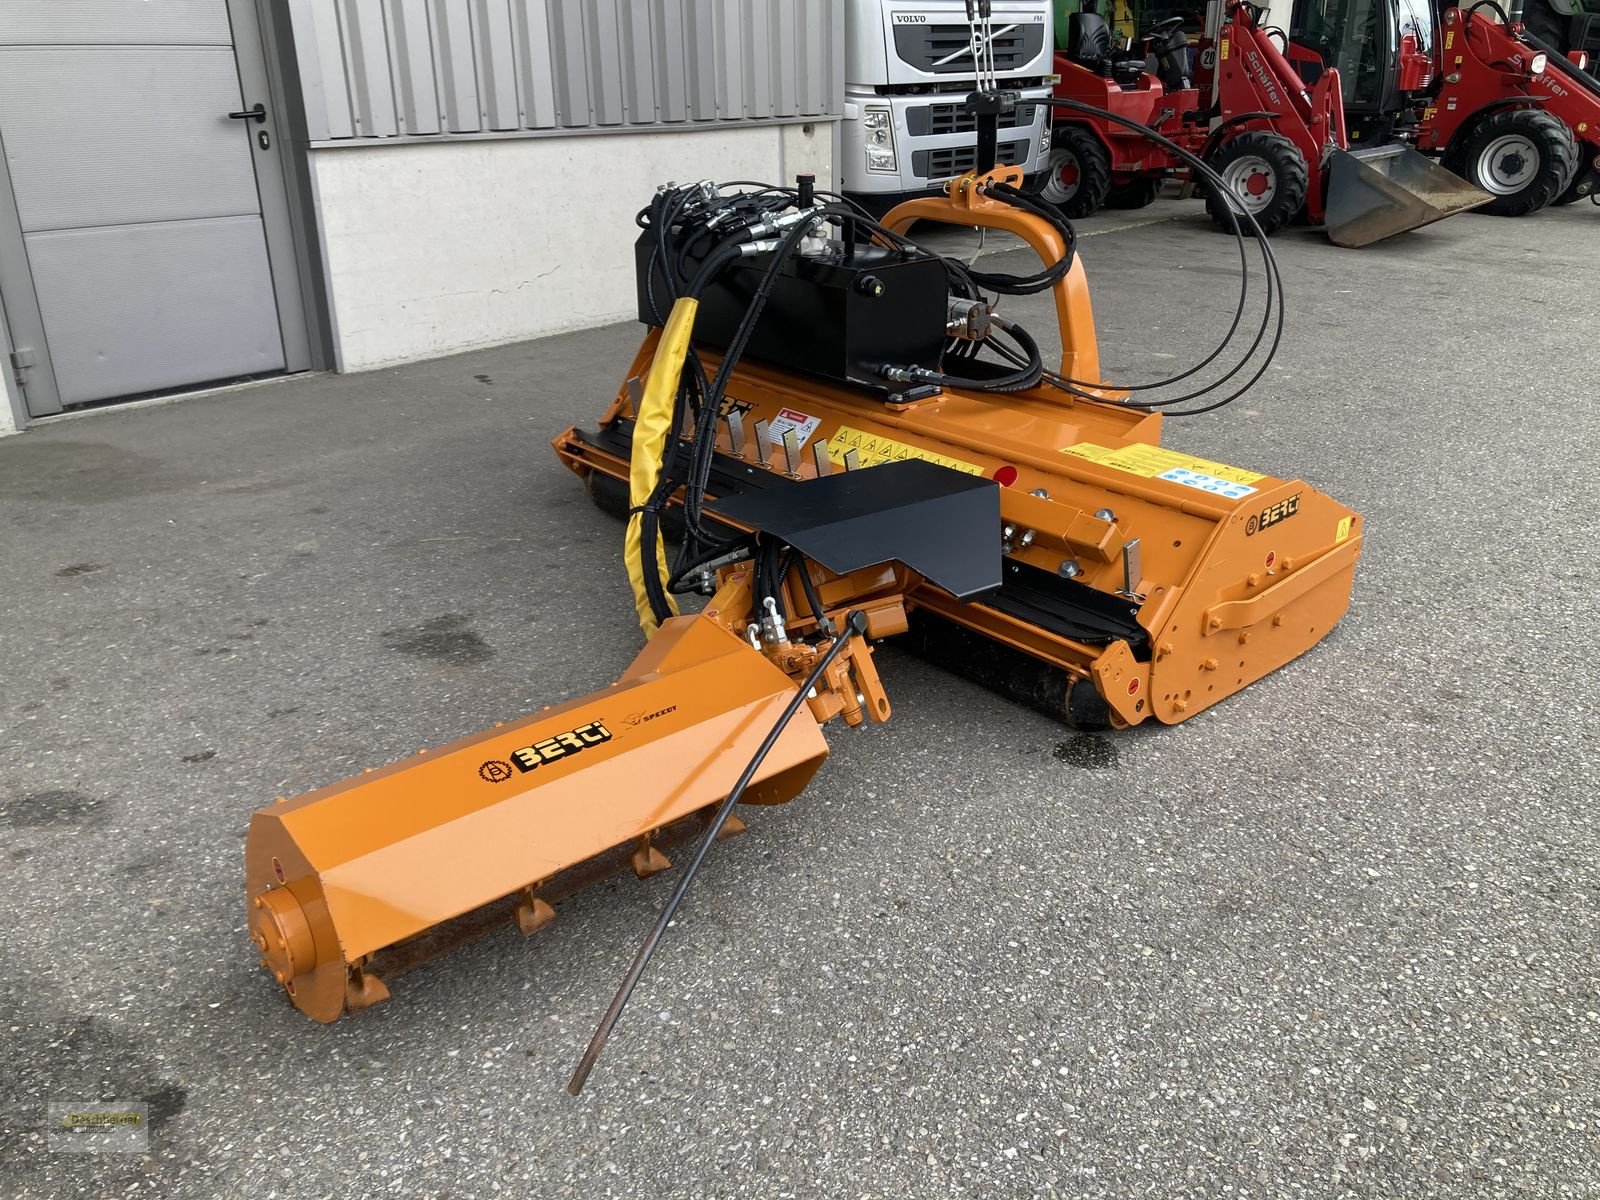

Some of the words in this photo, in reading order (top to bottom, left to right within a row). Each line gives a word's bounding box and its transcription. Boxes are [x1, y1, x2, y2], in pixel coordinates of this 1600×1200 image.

[896, 15, 926, 23] VOLVO
[1204, 51, 1215, 65] 20
[1246, 51, 1281, 106] Schäffer
[643, 705, 677, 722] SPEEDY
